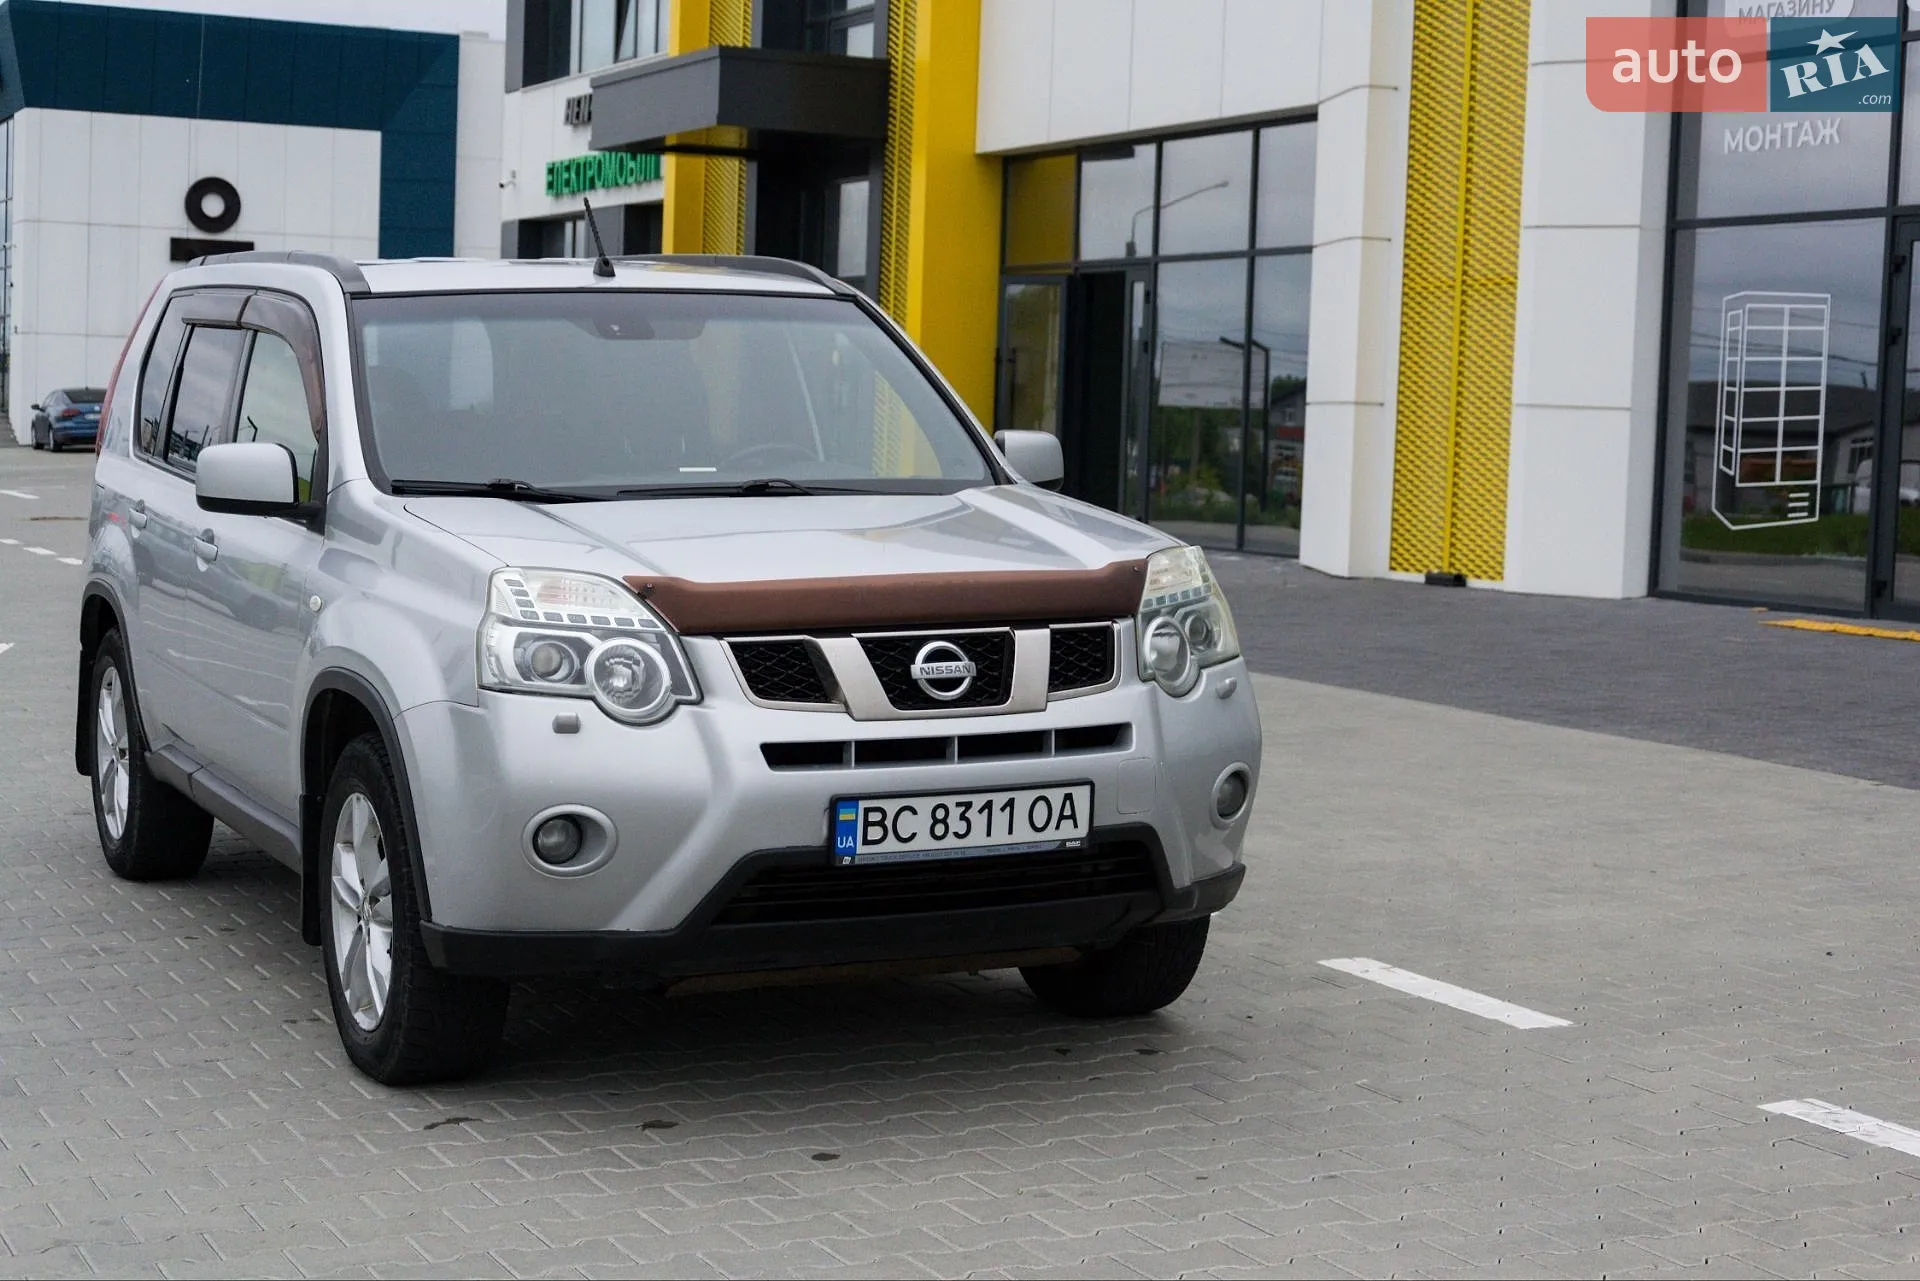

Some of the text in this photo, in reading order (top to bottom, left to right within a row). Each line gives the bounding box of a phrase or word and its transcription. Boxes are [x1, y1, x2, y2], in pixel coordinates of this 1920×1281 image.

[1723, 118, 1842, 155] МОНТАЖ
[919, 664, 971, 676] NISSAN
[861, 792, 1079, 846] BC 8311 OA
[837, 835, 855, 849] UA
